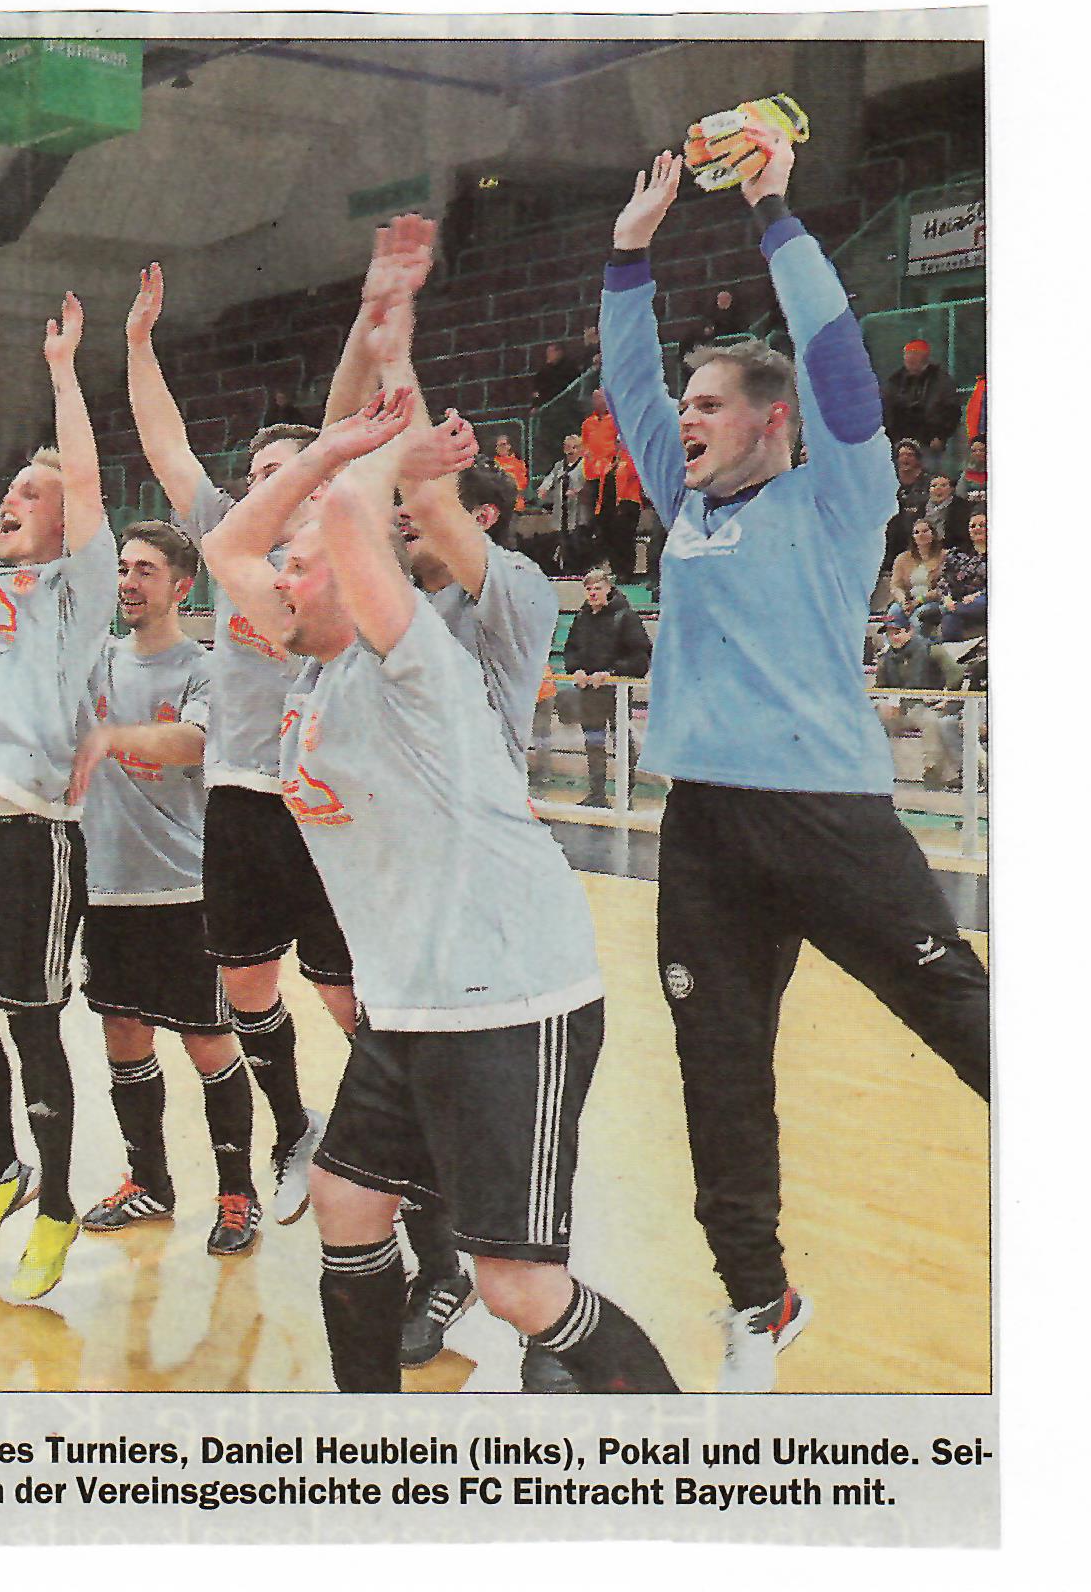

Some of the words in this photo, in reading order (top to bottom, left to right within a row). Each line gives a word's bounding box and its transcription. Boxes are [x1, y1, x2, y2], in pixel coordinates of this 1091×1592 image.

[43, 1434, 189, 1471] Turniers,
[200, 1435, 304, 1466] Daniel
[315, 1435, 459, 1466] Heublein
[468, 1435, 586, 1473] (links),
[598, 1436, 691, 1466] Pokal
[701, 1436, 761, 1470] und
[772, 1436, 920, 1467] Urkunde.
[930, 1436, 994, 1467] Sei-
[13, 1475, 68, 1505] der
[74, 1475, 383, 1512] Vereinsgeschichte
[390, 1476, 451, 1506] des
[459, 1475, 504, 1506] FC
[512, 1475, 665, 1507] Eintracht
[674, 1476, 823, 1513] Bayreuth
[832, 1476, 897, 1507] mit.
